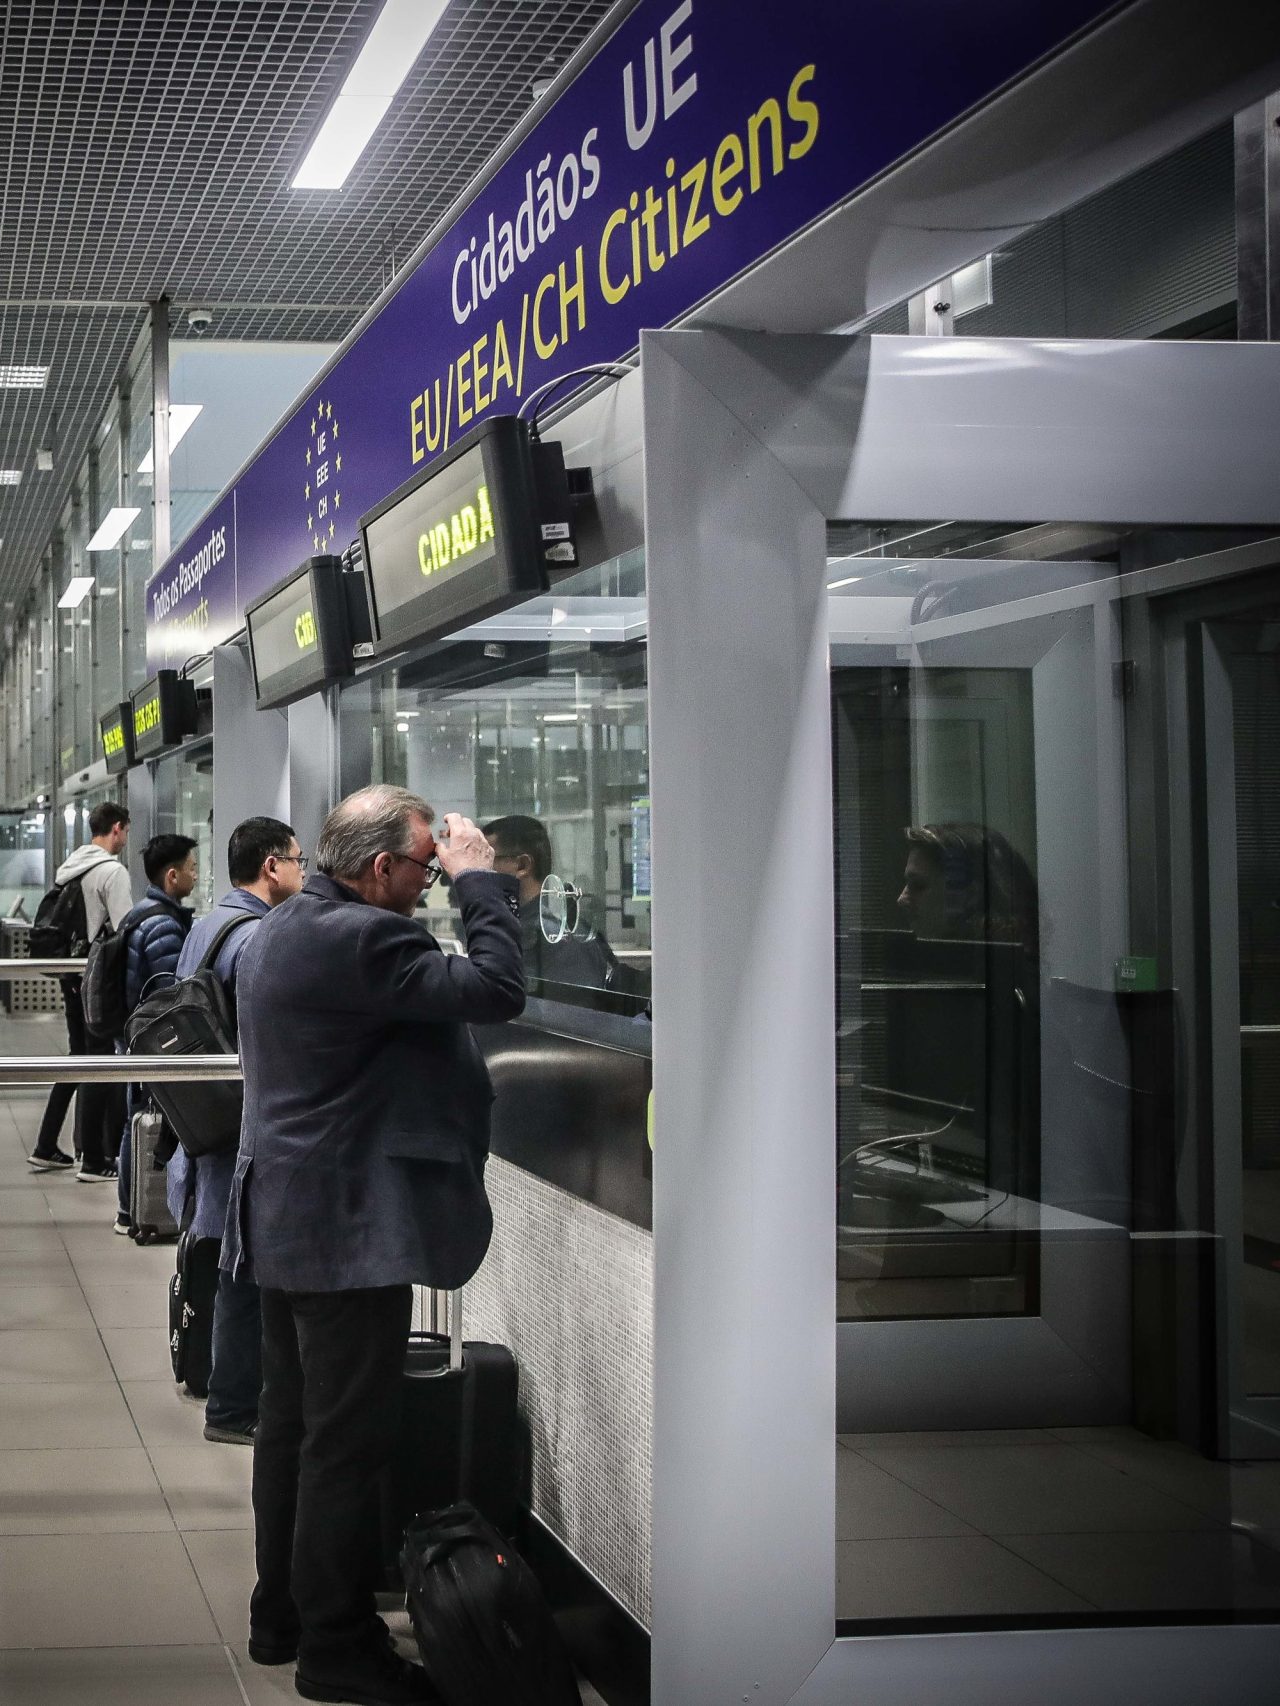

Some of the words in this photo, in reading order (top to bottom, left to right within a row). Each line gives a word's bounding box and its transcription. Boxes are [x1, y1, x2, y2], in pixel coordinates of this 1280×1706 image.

[452, 127, 601, 325] Cidadãos
[622, 0, 698, 150] UE
[409, 245, 586, 465] EU/EEA/CH
[599, 63, 819, 304] Citizens
[316, 460, 329, 488] EEE
[317, 431, 327, 456] UE
[318, 495, 328, 519] CH
[153, 583, 170, 624] Todos
[170, 575, 179, 607] os
[179, 525, 226, 599] Passaportes
